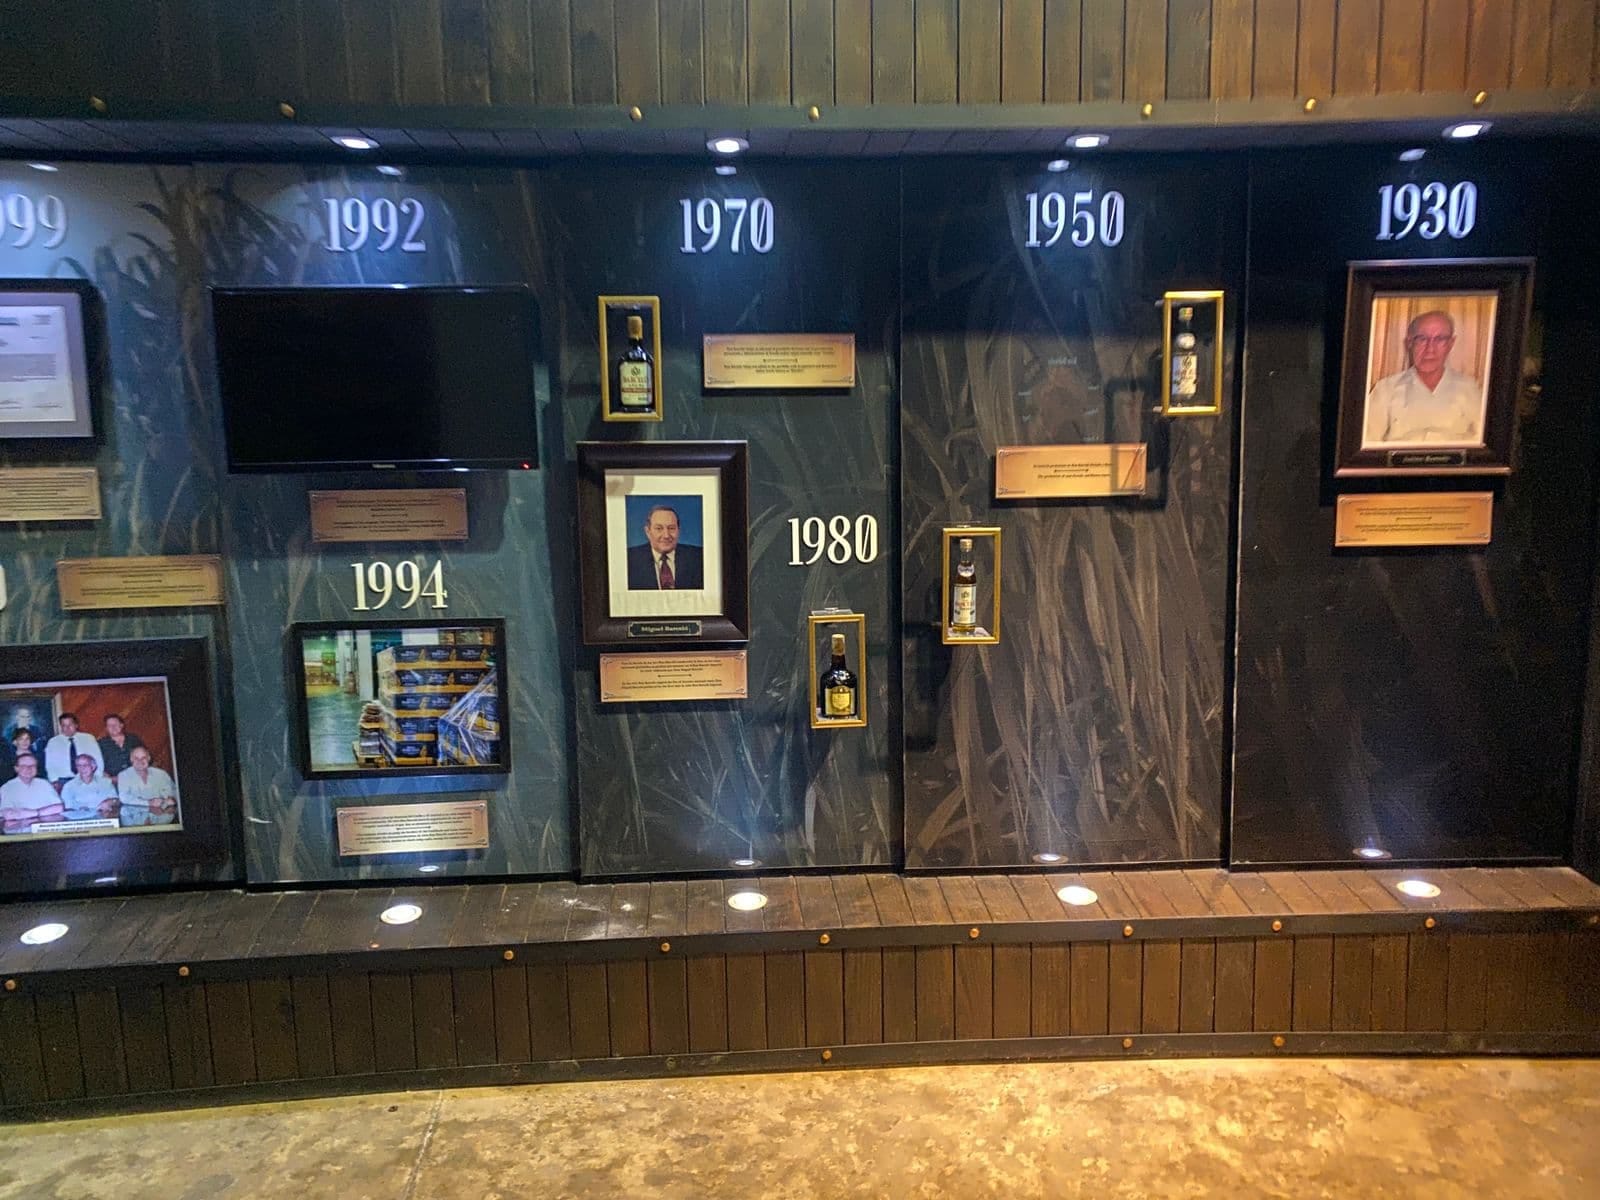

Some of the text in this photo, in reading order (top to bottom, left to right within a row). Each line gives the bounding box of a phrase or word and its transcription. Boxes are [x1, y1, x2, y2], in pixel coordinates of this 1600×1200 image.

[0, 193, 66, 248] 99
[322, 198, 426, 252] 1992
[679, 197, 774, 254] 1970
[1025, 189, 1125, 248] 1950
[1376, 181, 1477, 240] 1930
[787, 515, 878, 566] 1980
[350, 560, 449, 611] 1994
